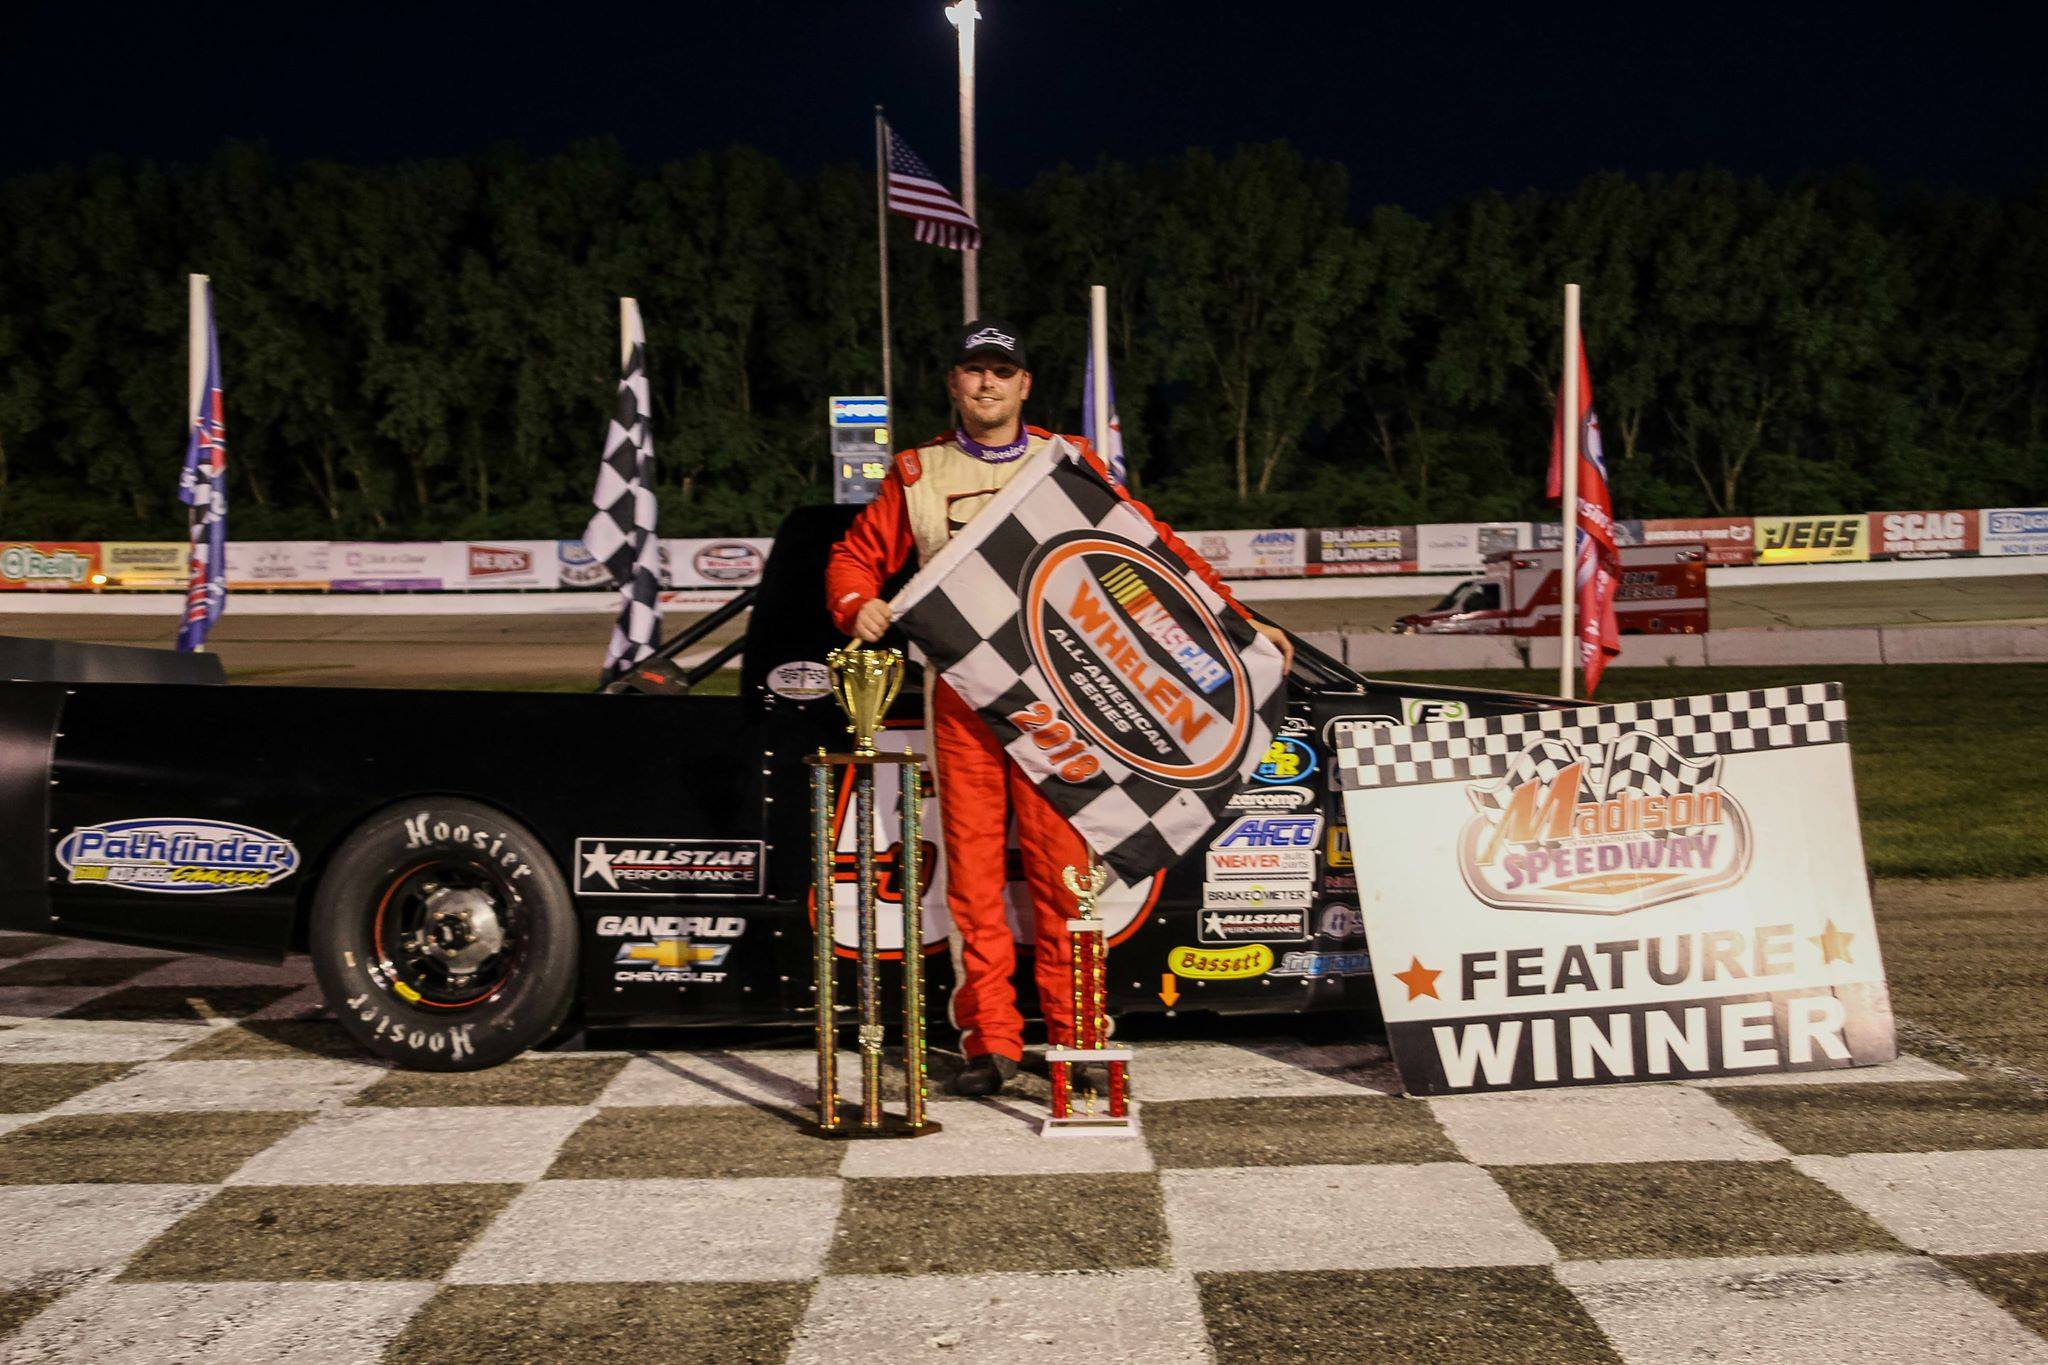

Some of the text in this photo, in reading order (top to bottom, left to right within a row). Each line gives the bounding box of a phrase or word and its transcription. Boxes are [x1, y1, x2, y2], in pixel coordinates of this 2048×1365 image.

[1320, 529, 1402, 543] BUMPER
[1765, 520, 1860, 549] JEGS
[1883, 512, 1966, 541] SCAG
[1320, 547, 1402, 562] BUMPER
[1068, 578, 1214, 746] WHELEN
[1130, 602, 1233, 695] NASCAR
[1048, 628, 1173, 755] ALL-AMERICAN
[1069, 671, 1133, 734] SERIES
[1007, 702, 1101, 784] 2018
[1477, 762, 1723, 866] Madison
[77, 830, 291, 866] Pathfinder
[404, 812, 532, 880] Hoosier
[611, 850, 757, 866] ALLSTAR
[1212, 855, 1281, 868] WEAVER
[1502, 833, 1718, 890] SPEEDWAY
[614, 869, 755, 881] PERFORMANCE
[596, 916, 747, 937] GANDRUD
[1221, 913, 1302, 925] ALLSTAR
[614, 971, 728, 983] CHEVROLET
[1181, 952, 1262, 972] Bassett
[1459, 923, 1796, 1001] FEATURE
[346, 992, 478, 1062] Hoosier
[1432, 996, 1852, 1089] WINNER
